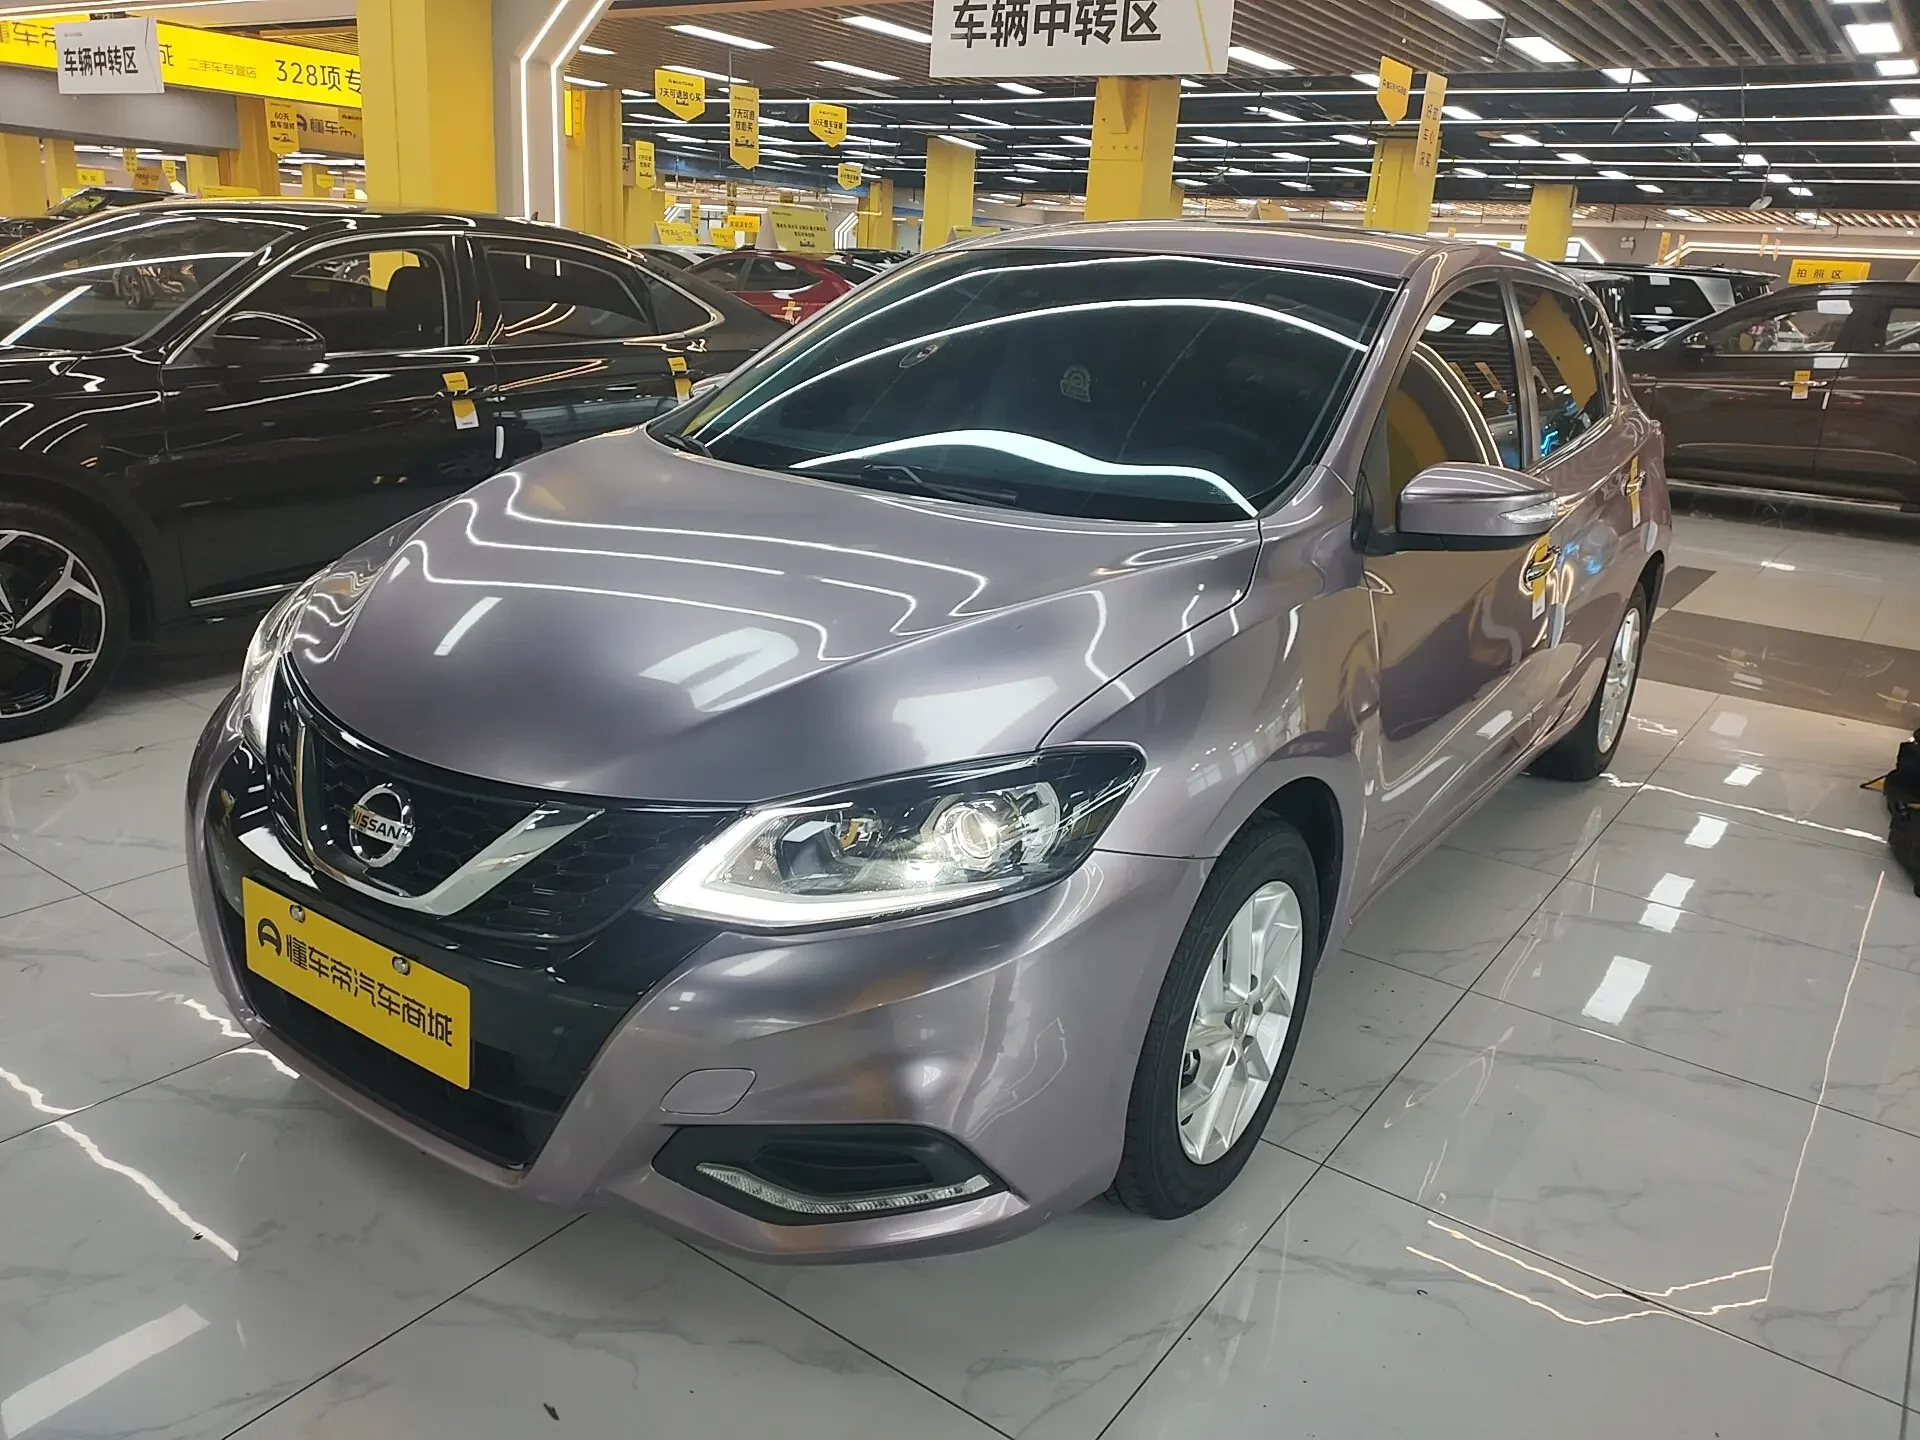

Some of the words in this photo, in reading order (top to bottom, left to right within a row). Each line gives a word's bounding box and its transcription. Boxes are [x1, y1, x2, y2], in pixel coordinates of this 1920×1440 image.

[950, 0, 1161, 48] 车辆中转区
[63, 45, 138, 77] 车辆中转区
[188, 58, 257, 79] 二手车专营店
[274, 112, 290, 121] 60天
[1796, 268, 1844, 280] 拍照区
[351, 808, 402, 840] NISSAN
[285, 933, 453, 1048] 懂车帝汽车商城
